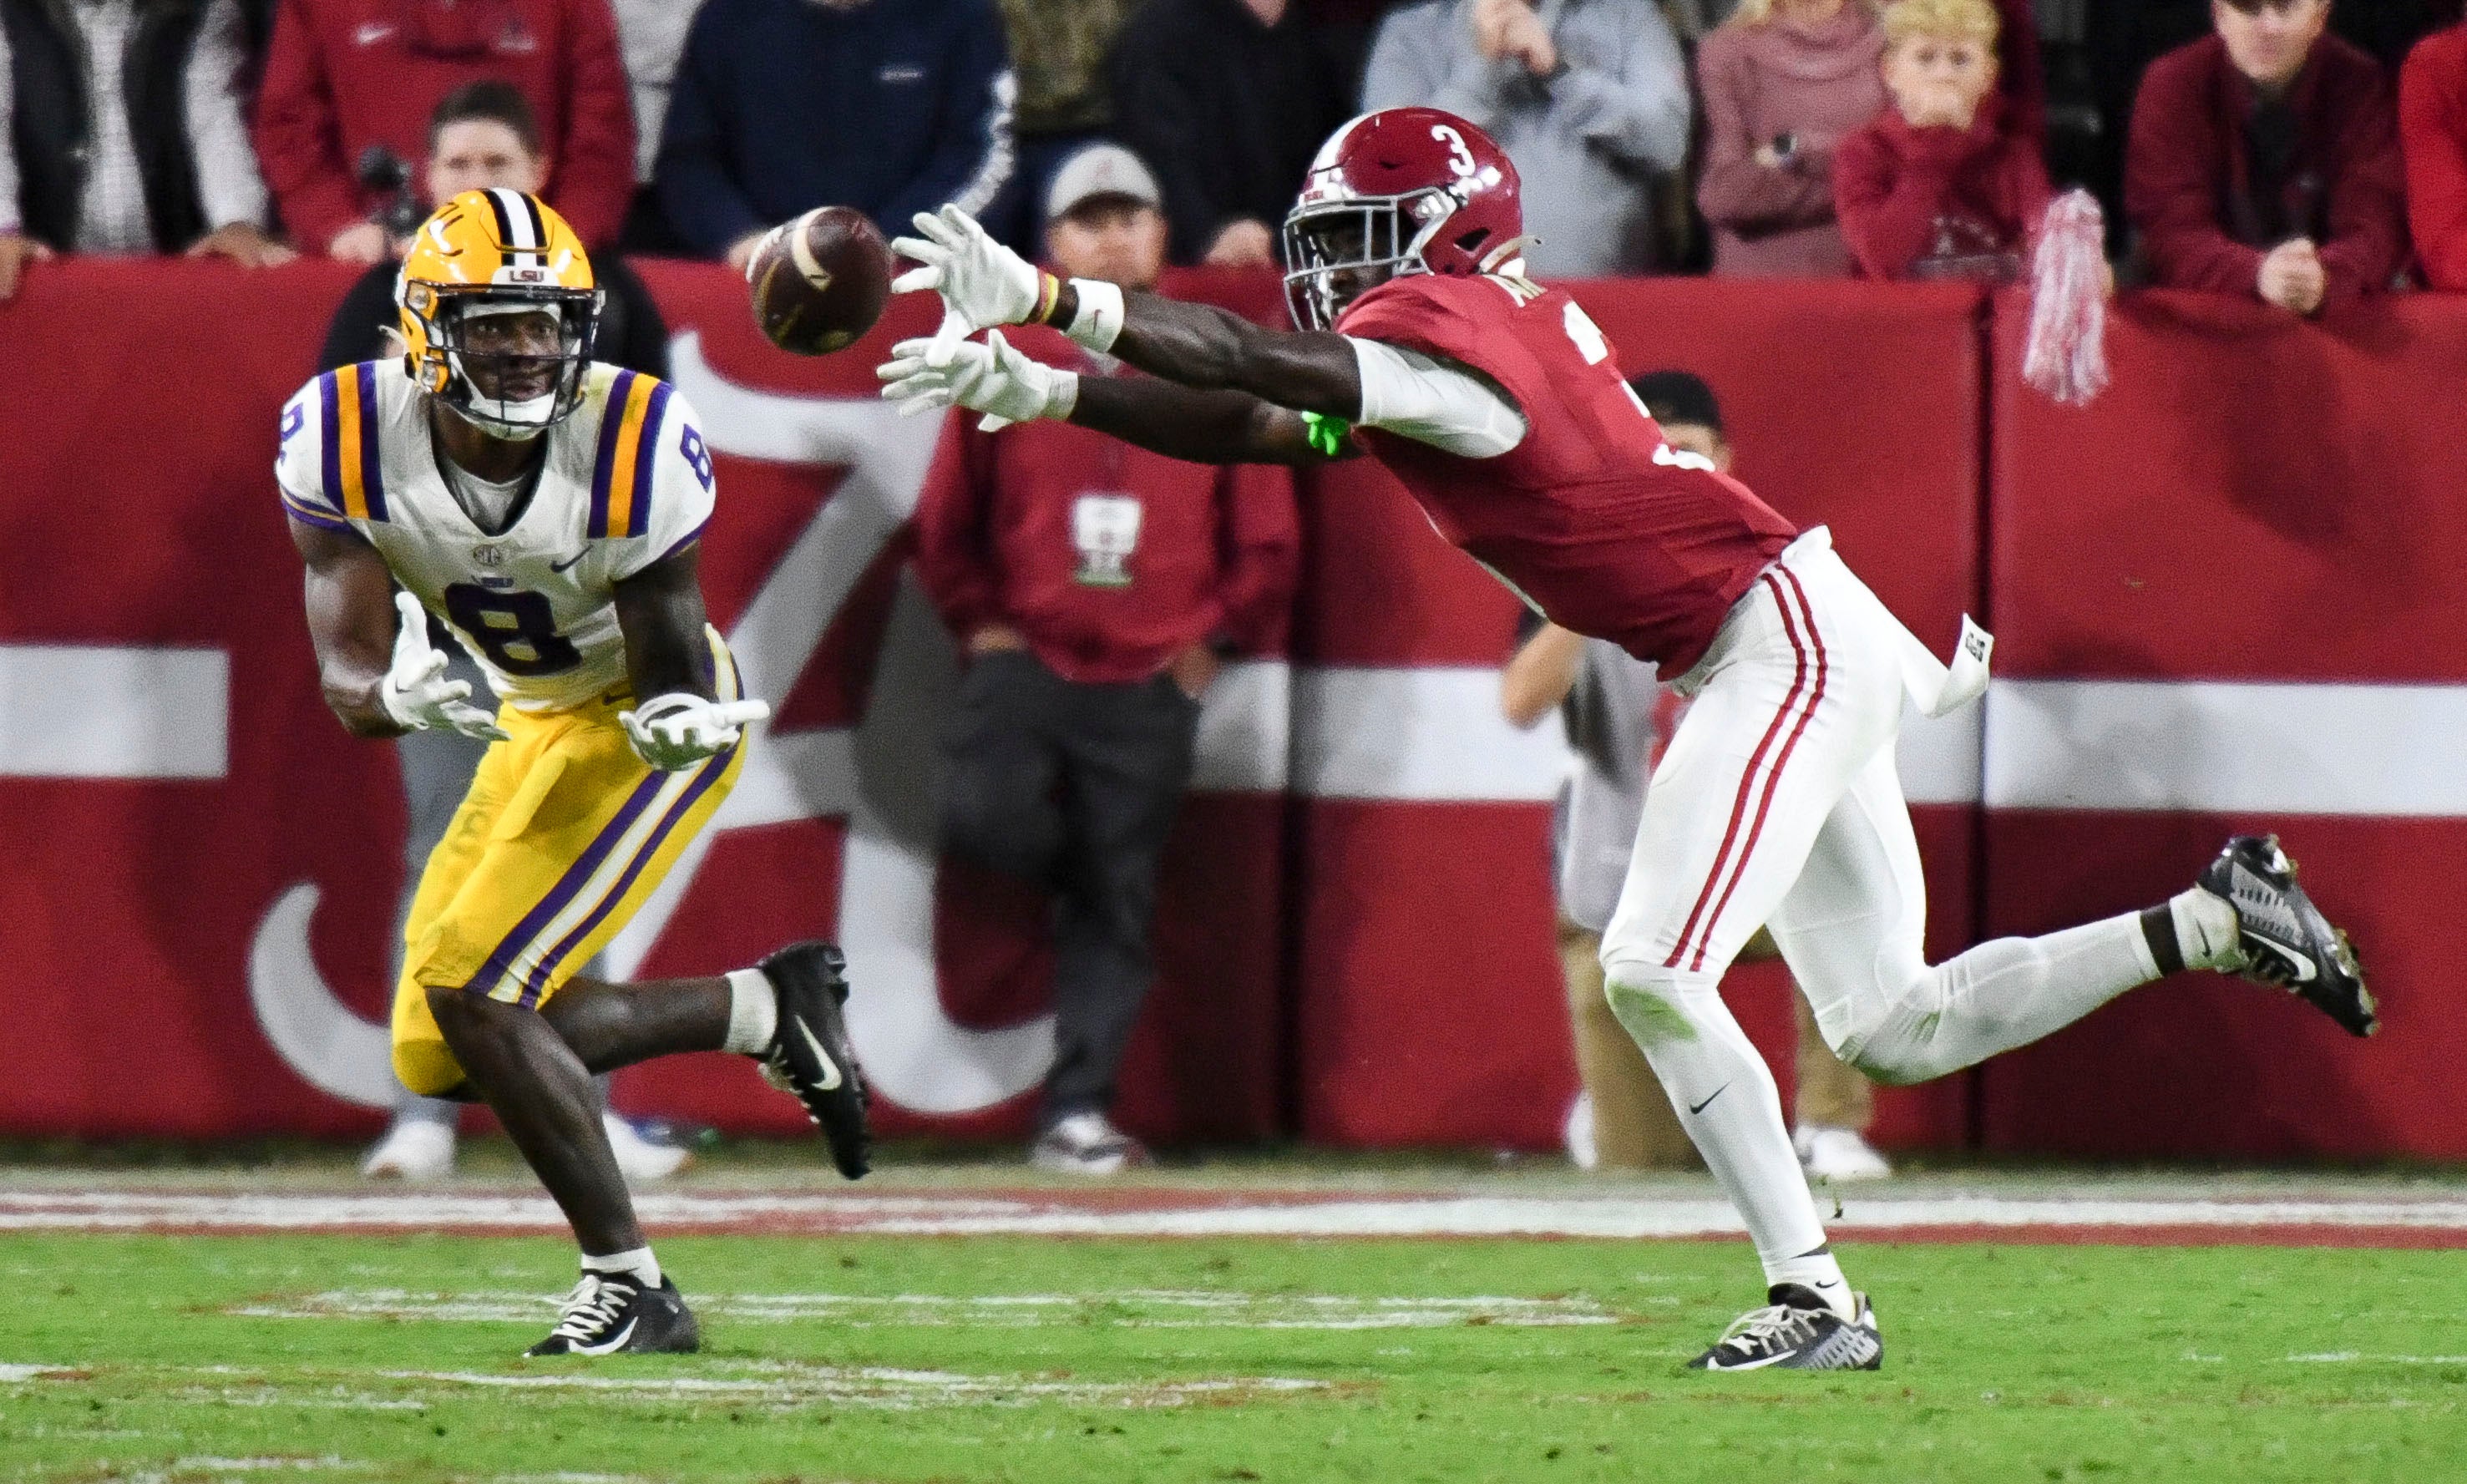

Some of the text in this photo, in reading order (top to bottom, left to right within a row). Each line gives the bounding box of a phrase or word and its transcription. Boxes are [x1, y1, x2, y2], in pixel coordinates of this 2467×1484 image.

[1431, 124, 1476, 176] 3
[509, 270, 545, 282] LSU
[680, 423, 713, 494] 8
[444, 582, 584, 675] 8
